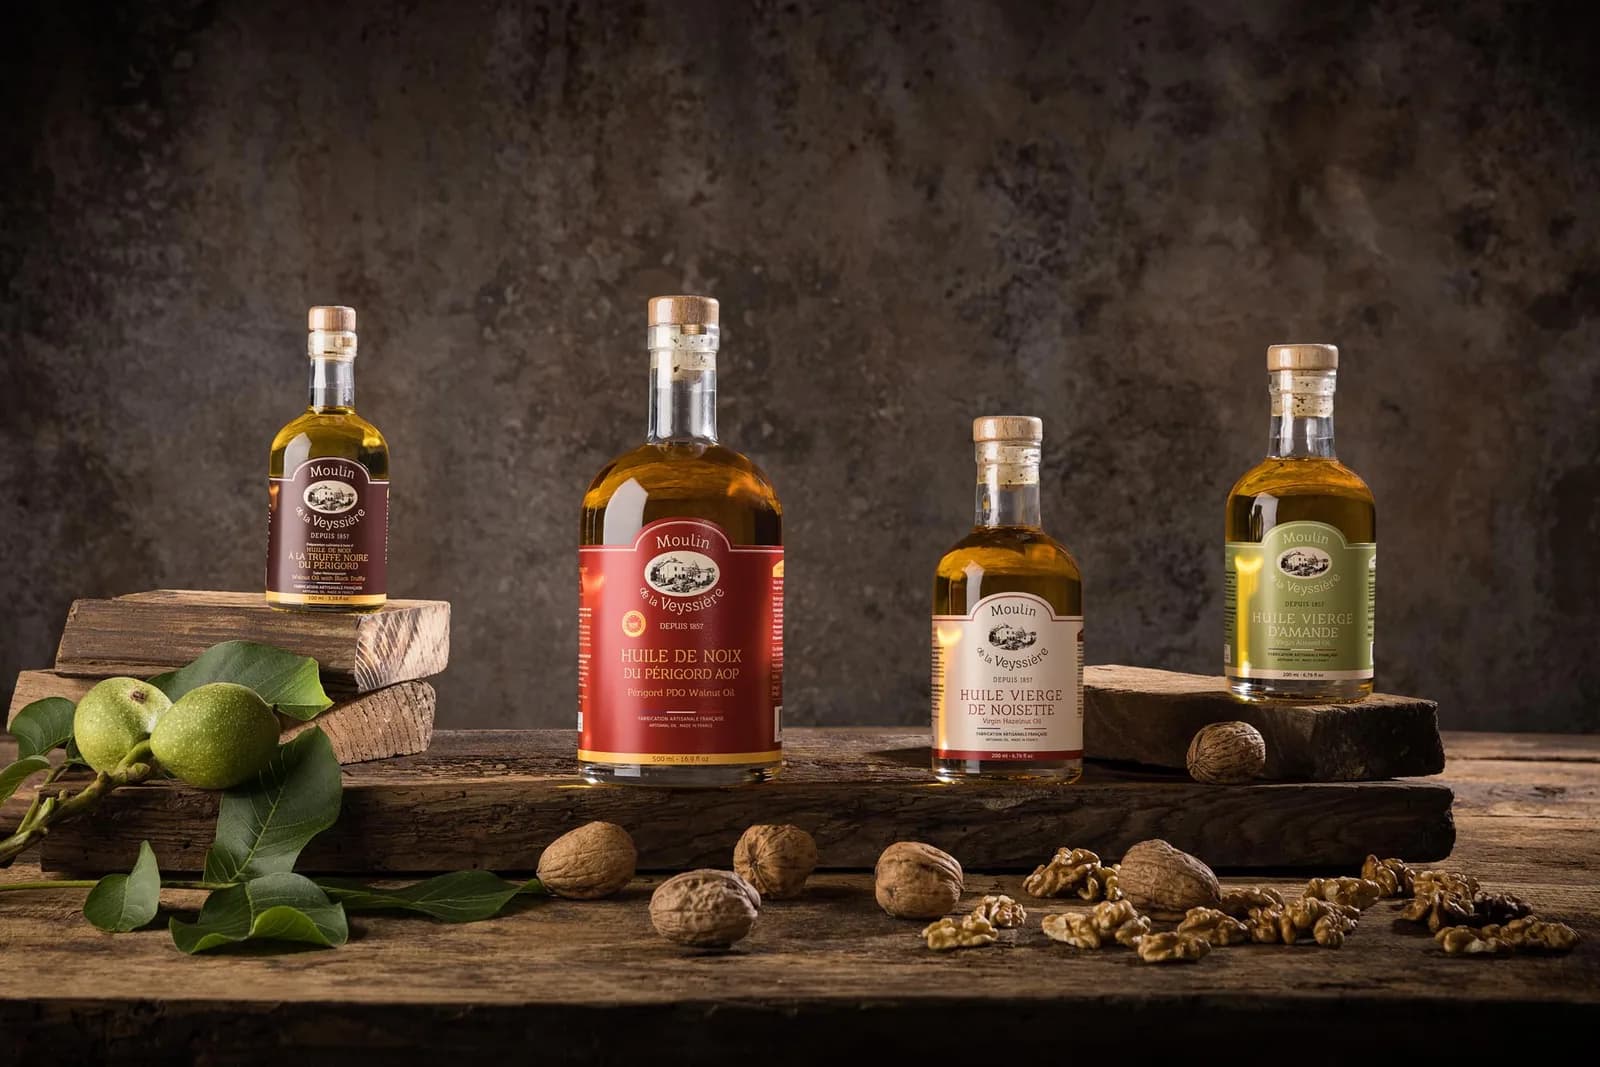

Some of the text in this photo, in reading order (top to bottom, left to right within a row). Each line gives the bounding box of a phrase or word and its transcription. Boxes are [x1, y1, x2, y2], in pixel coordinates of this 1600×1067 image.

[310, 465, 355, 480] Moulin
[296, 506, 366, 531] de la Veyssière
[656, 534, 710, 549] Moulin
[1283, 532, 1328, 544] Moulin
[296, 552, 306, 561] LA
[308, 553, 342, 562] TRUFFE
[344, 554, 368, 562] NOIRE
[298, 561, 310, 569] DU
[1288, 574, 1340, 596] Veyssière
[640, 587, 724, 615] de la Veyssière
[991, 604, 1036, 616] Moulin
[1252, 612, 1352, 624] HUILE VIERGE
[1268, 625, 1338, 638] D'AMANDE
[621, 649, 742, 662] HUILE DE NOIX
[977, 647, 1048, 671] de la Veyssière
[624, 666, 740, 680] DU PÉRIGORD AOP
[627, 688, 735, 699] Périgord PDO Walnut Oil
[960, 690, 1062, 700] HUILE VIERGE
[968, 704, 1054, 716] DE NOISETTE
[982, 718, 1001, 726] Virgin
